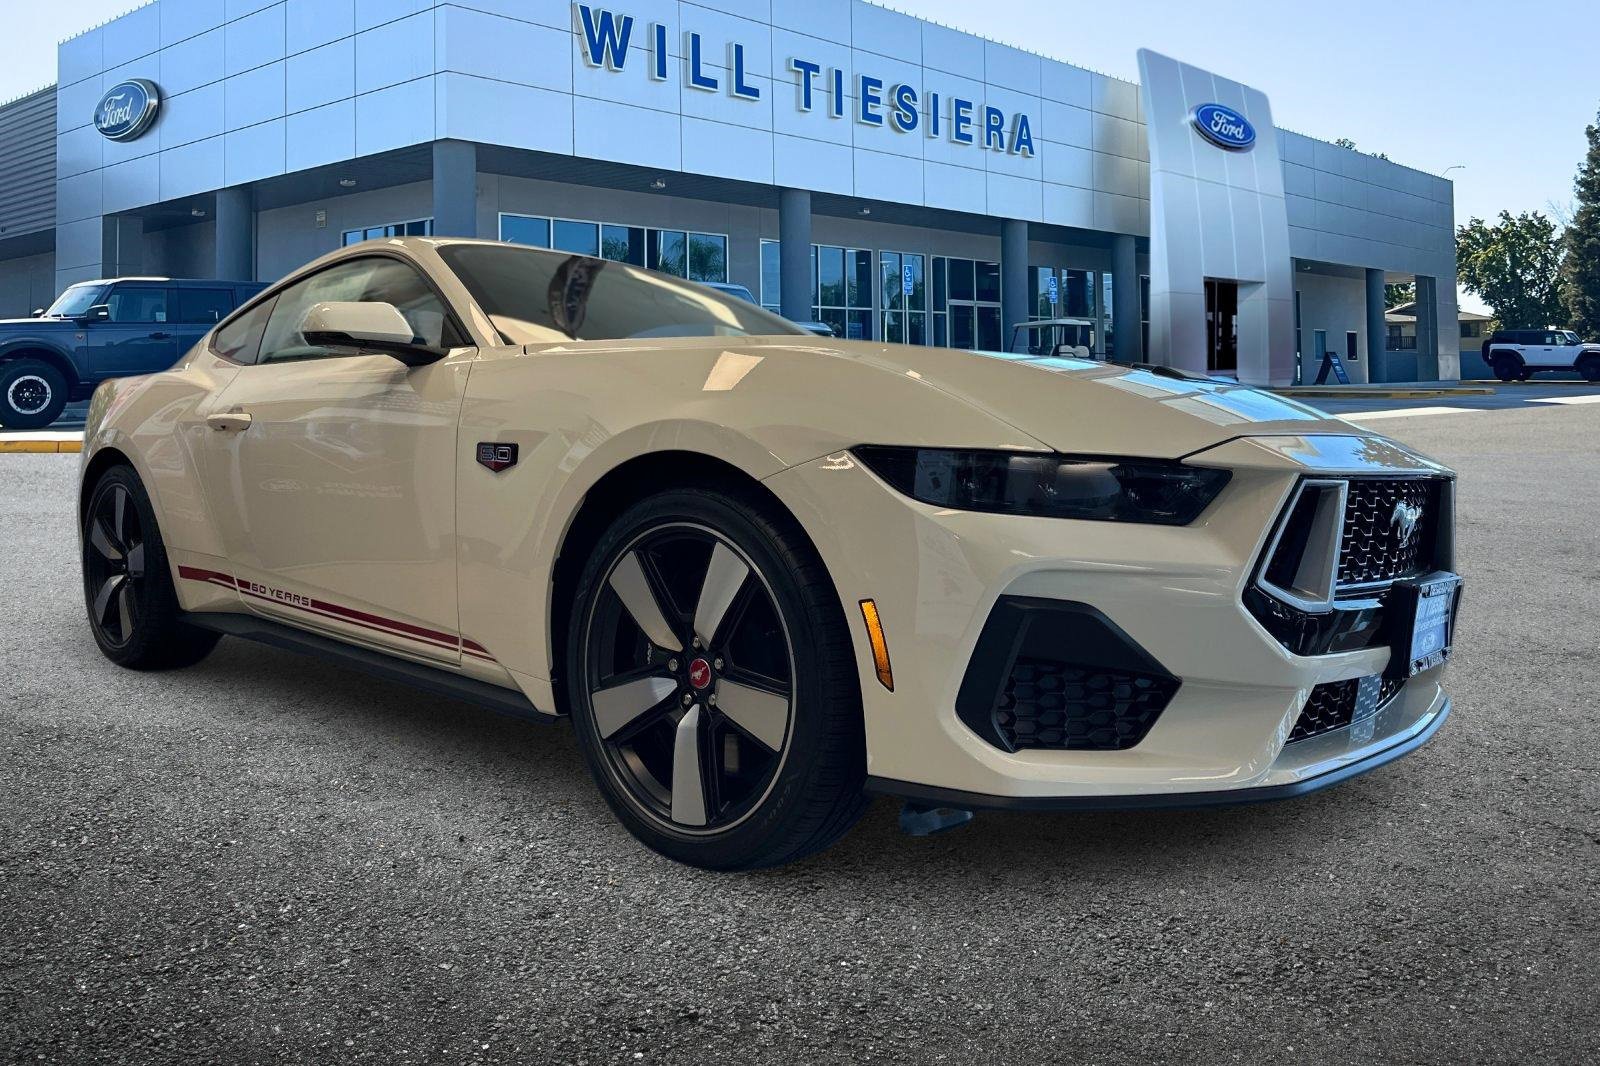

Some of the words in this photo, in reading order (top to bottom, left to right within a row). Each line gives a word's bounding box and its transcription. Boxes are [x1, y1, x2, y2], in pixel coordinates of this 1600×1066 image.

[576, 3, 760, 101] WILL
[789, 57, 1035, 158] TIESIERA
[101, 93, 133, 128] Ford
[1211, 110, 1245, 139] Ford
[251, 583, 267, 595] 60
[269, 587, 310, 607] YEARS
